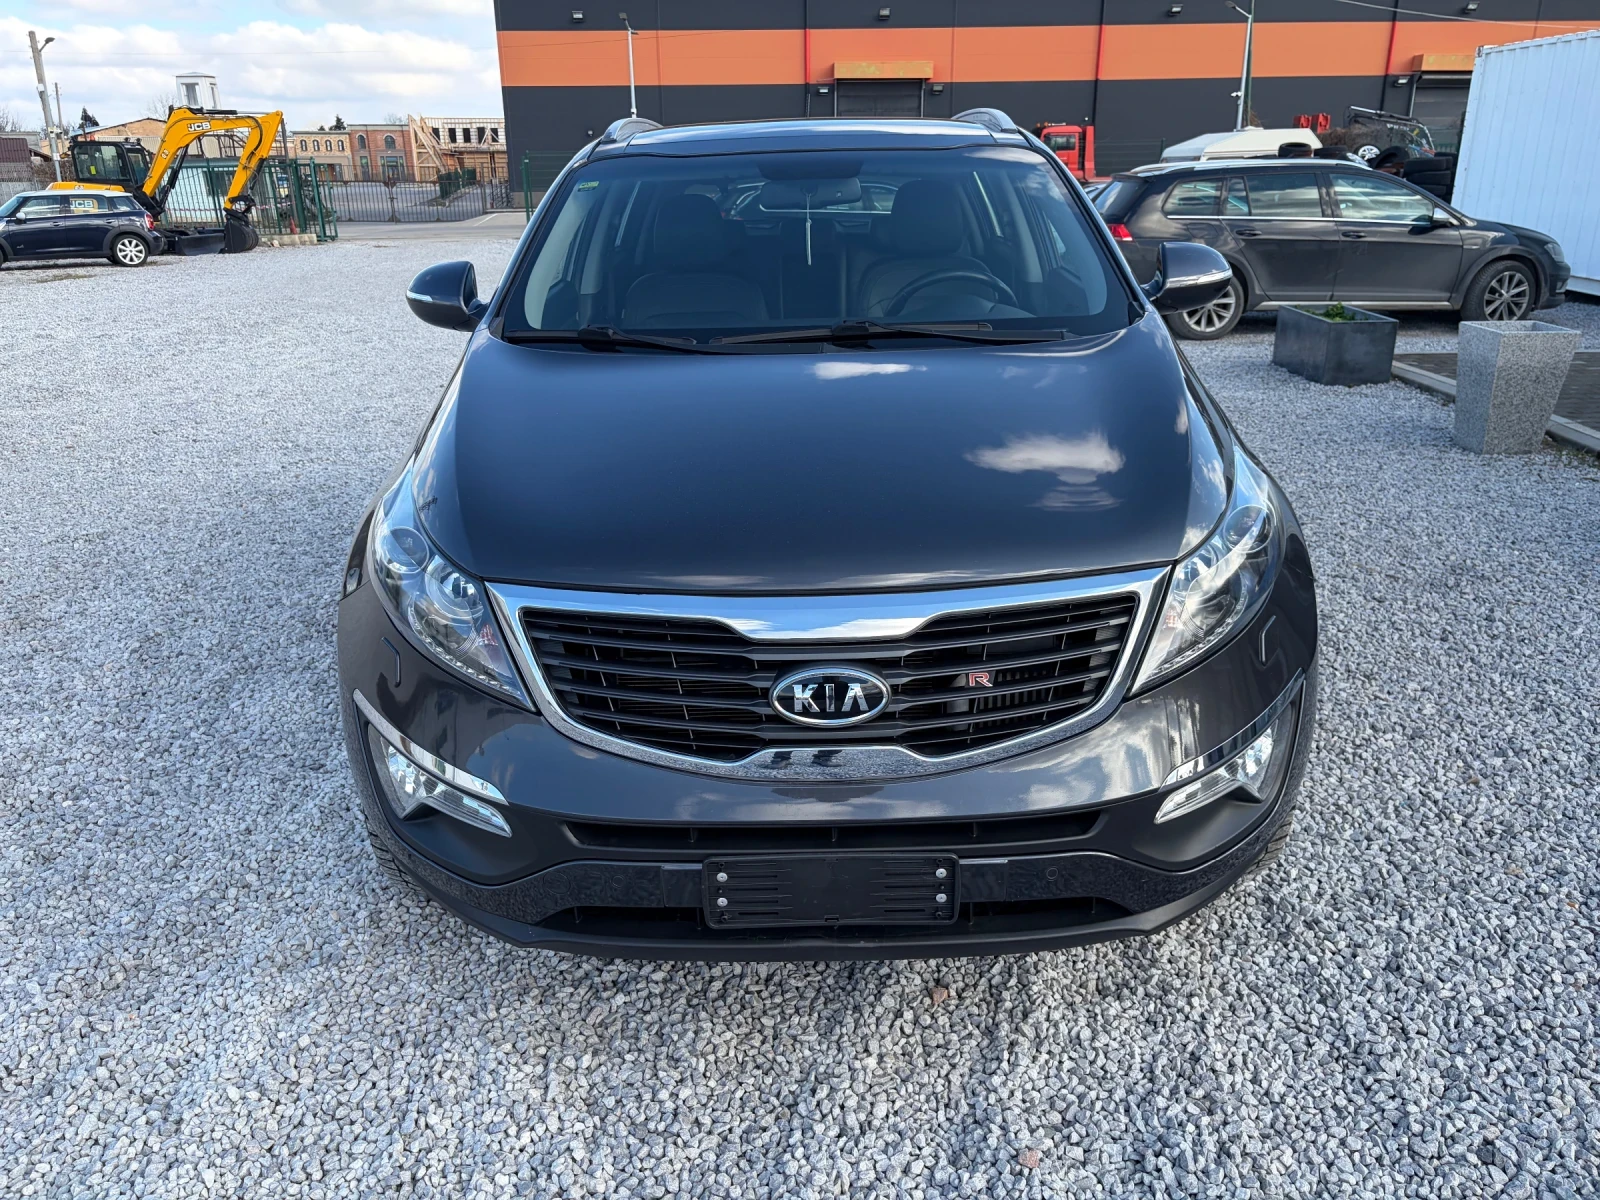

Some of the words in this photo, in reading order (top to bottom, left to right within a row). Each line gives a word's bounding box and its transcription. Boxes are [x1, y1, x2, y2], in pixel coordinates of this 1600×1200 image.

[187, 121, 211, 132] JCB
[70, 200, 94, 208] JCB
[969, 672, 993, 687] R
[791, 683, 870, 713] KIA
